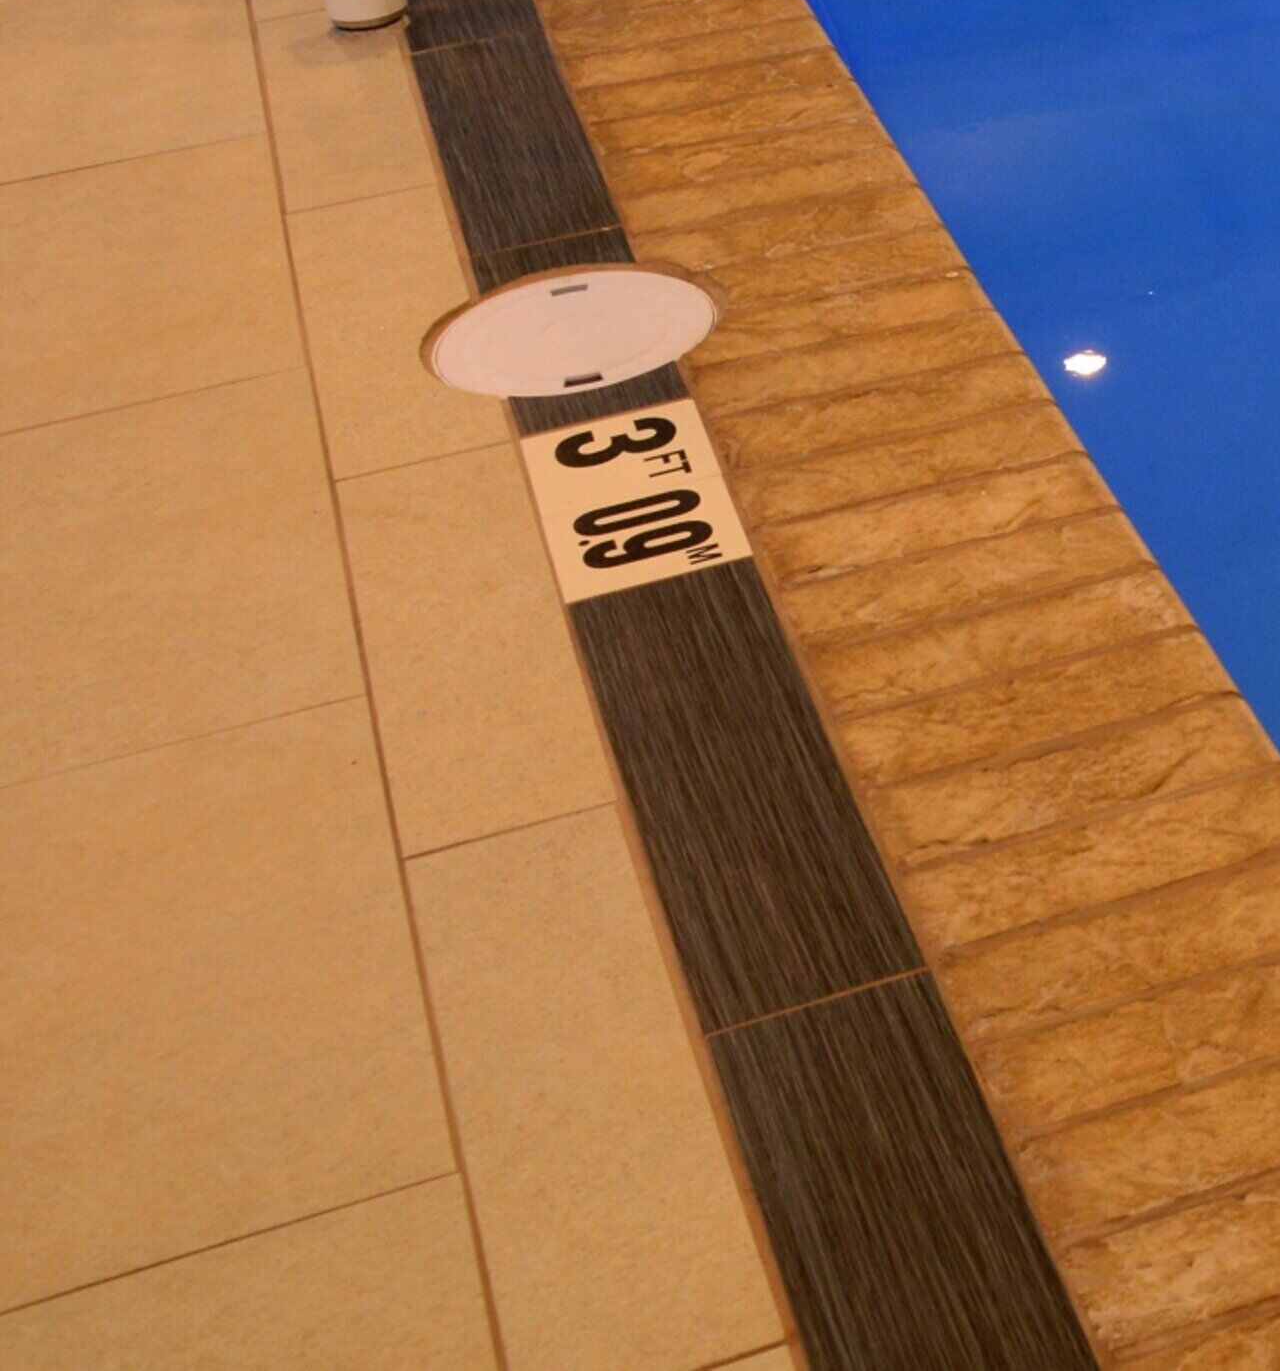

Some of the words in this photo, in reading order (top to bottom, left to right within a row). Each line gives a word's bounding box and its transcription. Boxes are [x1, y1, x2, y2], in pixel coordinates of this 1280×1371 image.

[554, 416, 677, 469] 3
[643, 448, 693, 479] FT
[685, 542, 724, 566] M
